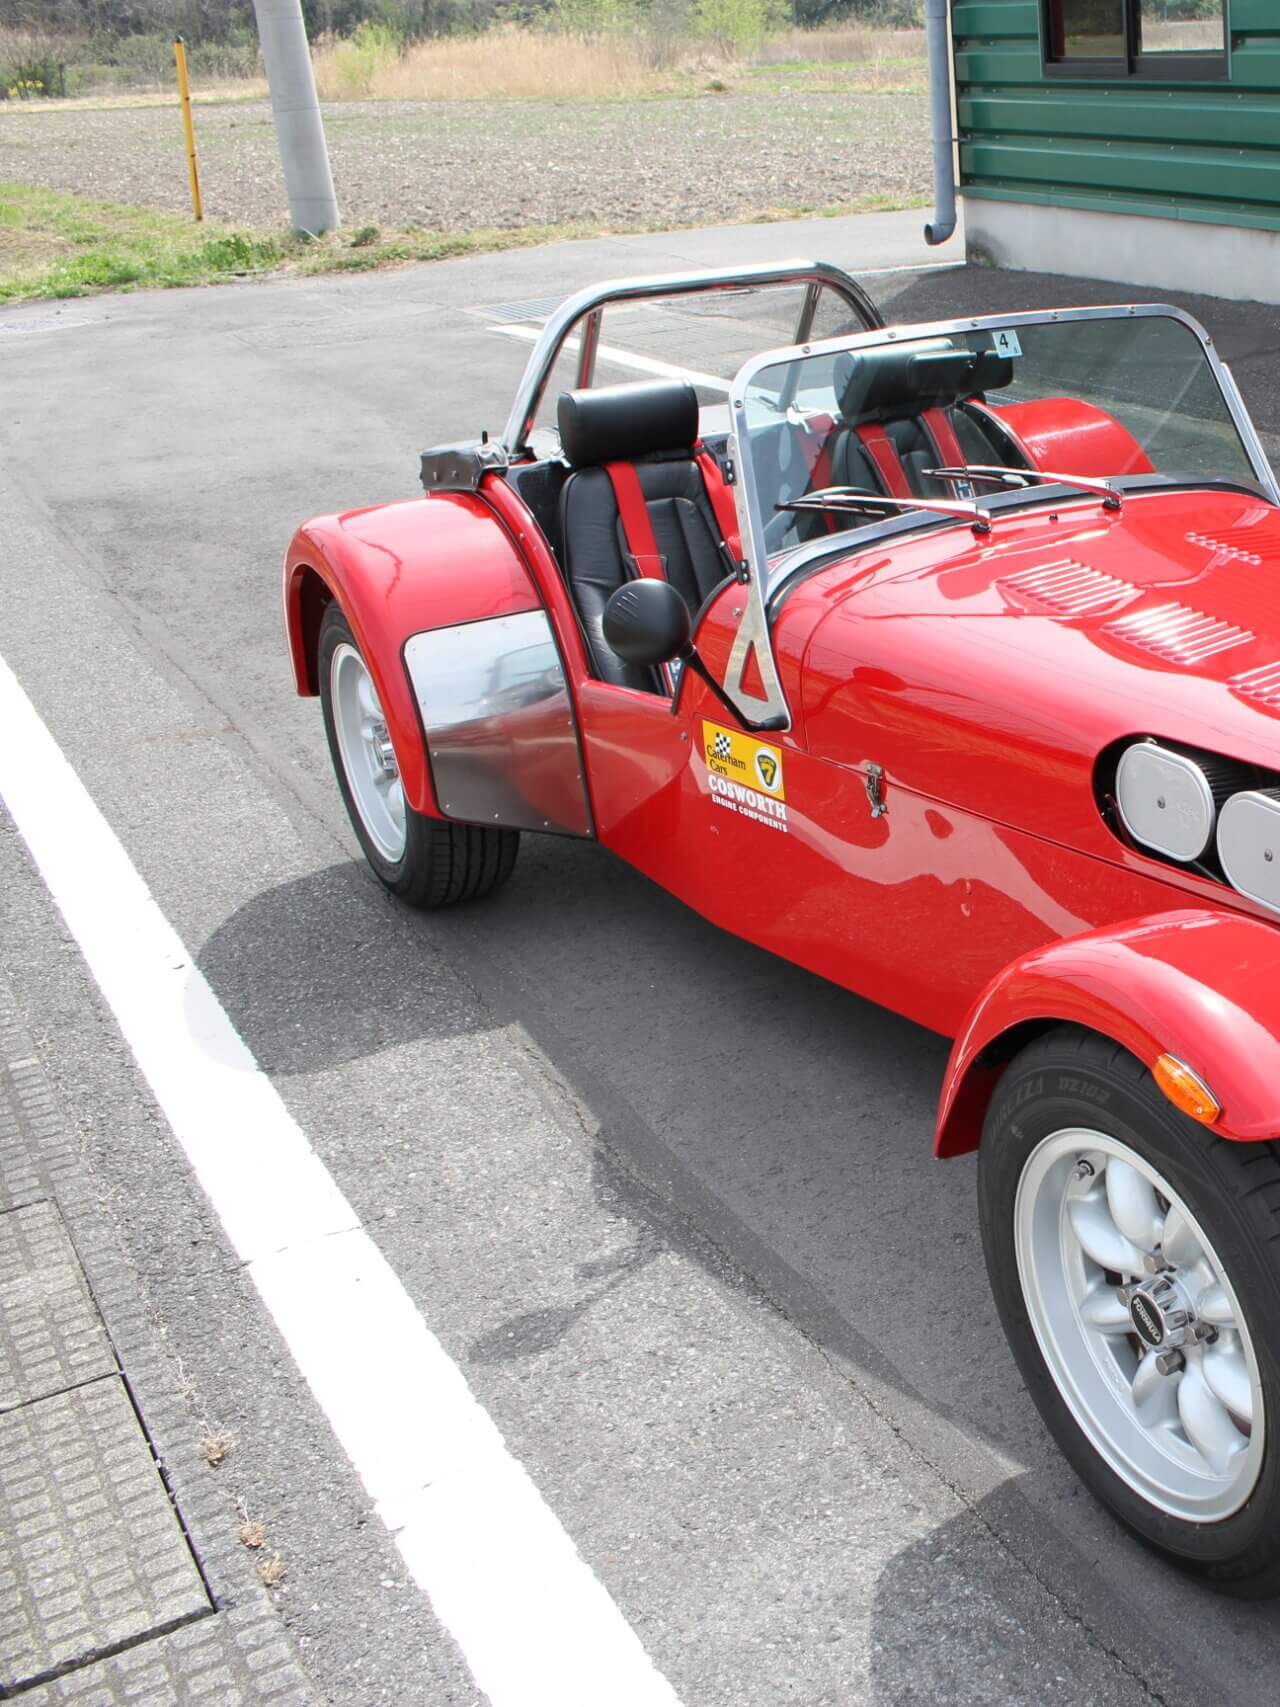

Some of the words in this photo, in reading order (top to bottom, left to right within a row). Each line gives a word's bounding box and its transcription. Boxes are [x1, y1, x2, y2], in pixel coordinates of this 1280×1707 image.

[999, 333, 1009, 348] 4
[706, 744, 747, 770] Caterham
[709, 758, 728, 776] Cars
[708, 774, 788, 820] COSWORTH
[712, 793, 738, 812] ENGINE
[738, 805, 788, 833] COMPONENTS
[1132, 1296, 1162, 1344] FORMULA
